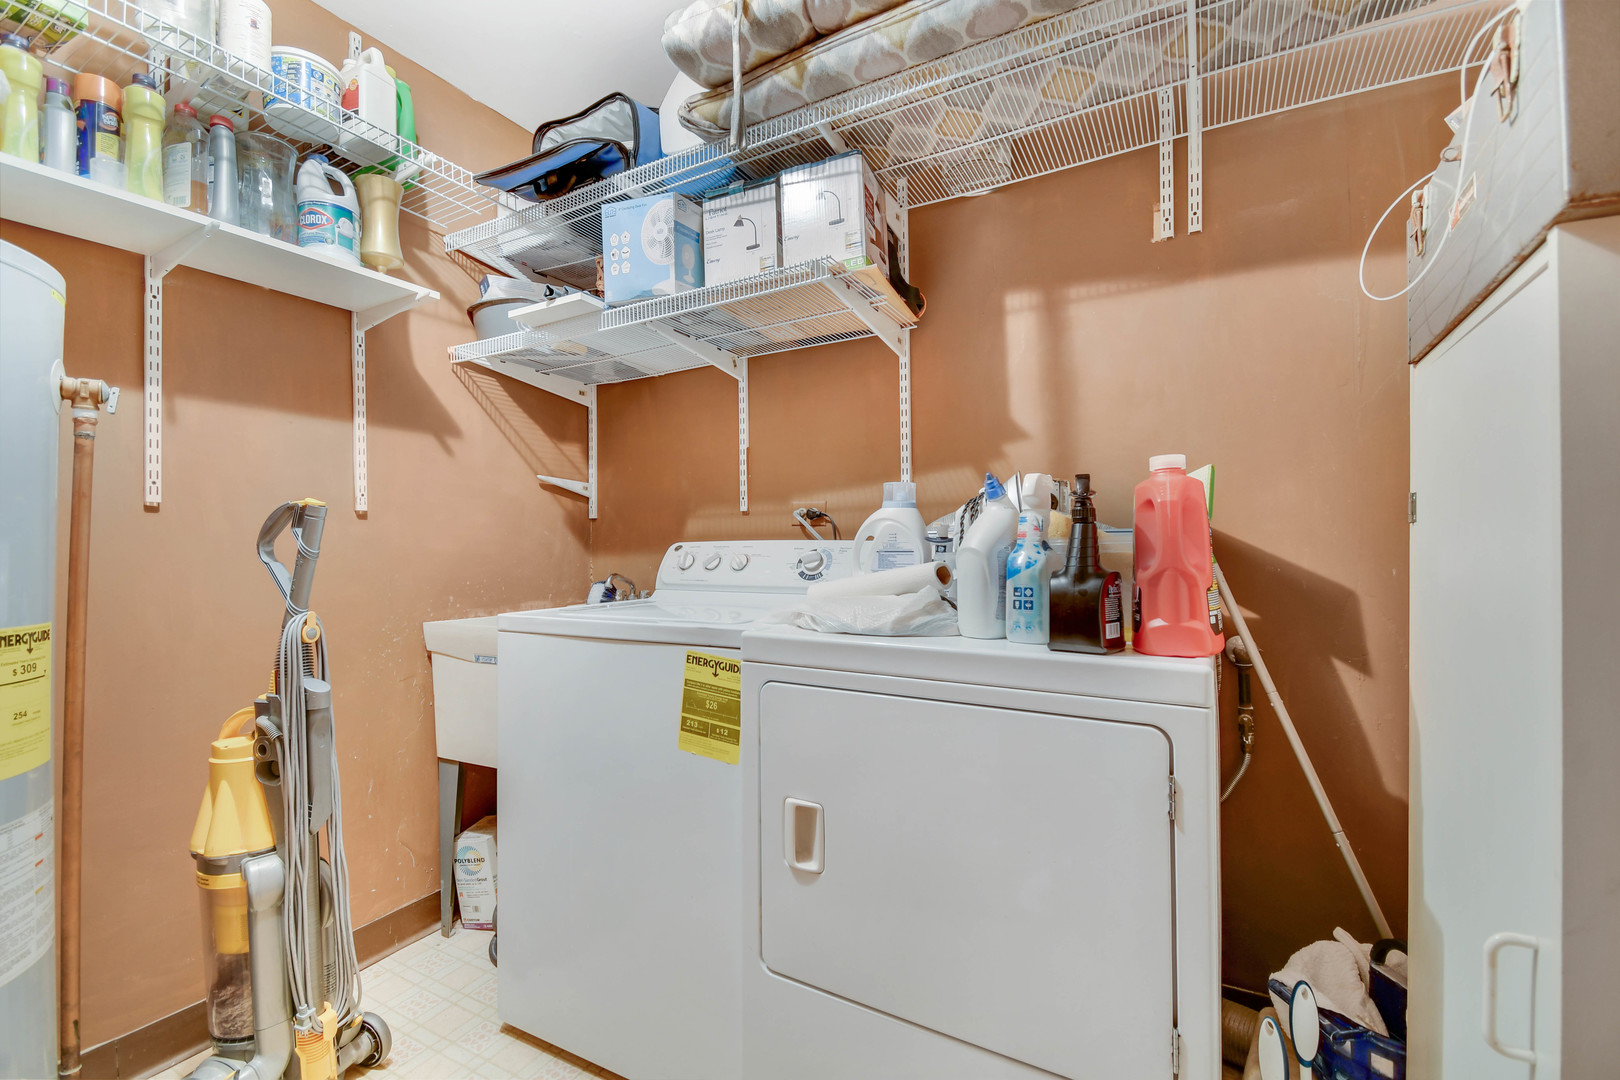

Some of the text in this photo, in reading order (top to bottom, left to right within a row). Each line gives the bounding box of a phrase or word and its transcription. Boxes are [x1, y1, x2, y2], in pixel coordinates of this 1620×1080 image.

[299, 214, 328, 225] CLOROX
[844, 257, 865, 268] LED
[0, 629, 51, 650] NERGYGUIDE
[20, 662, 37, 676] 309
[686, 654, 741, 675] ENERGYGUID
[13, 710, 28, 720] 254
